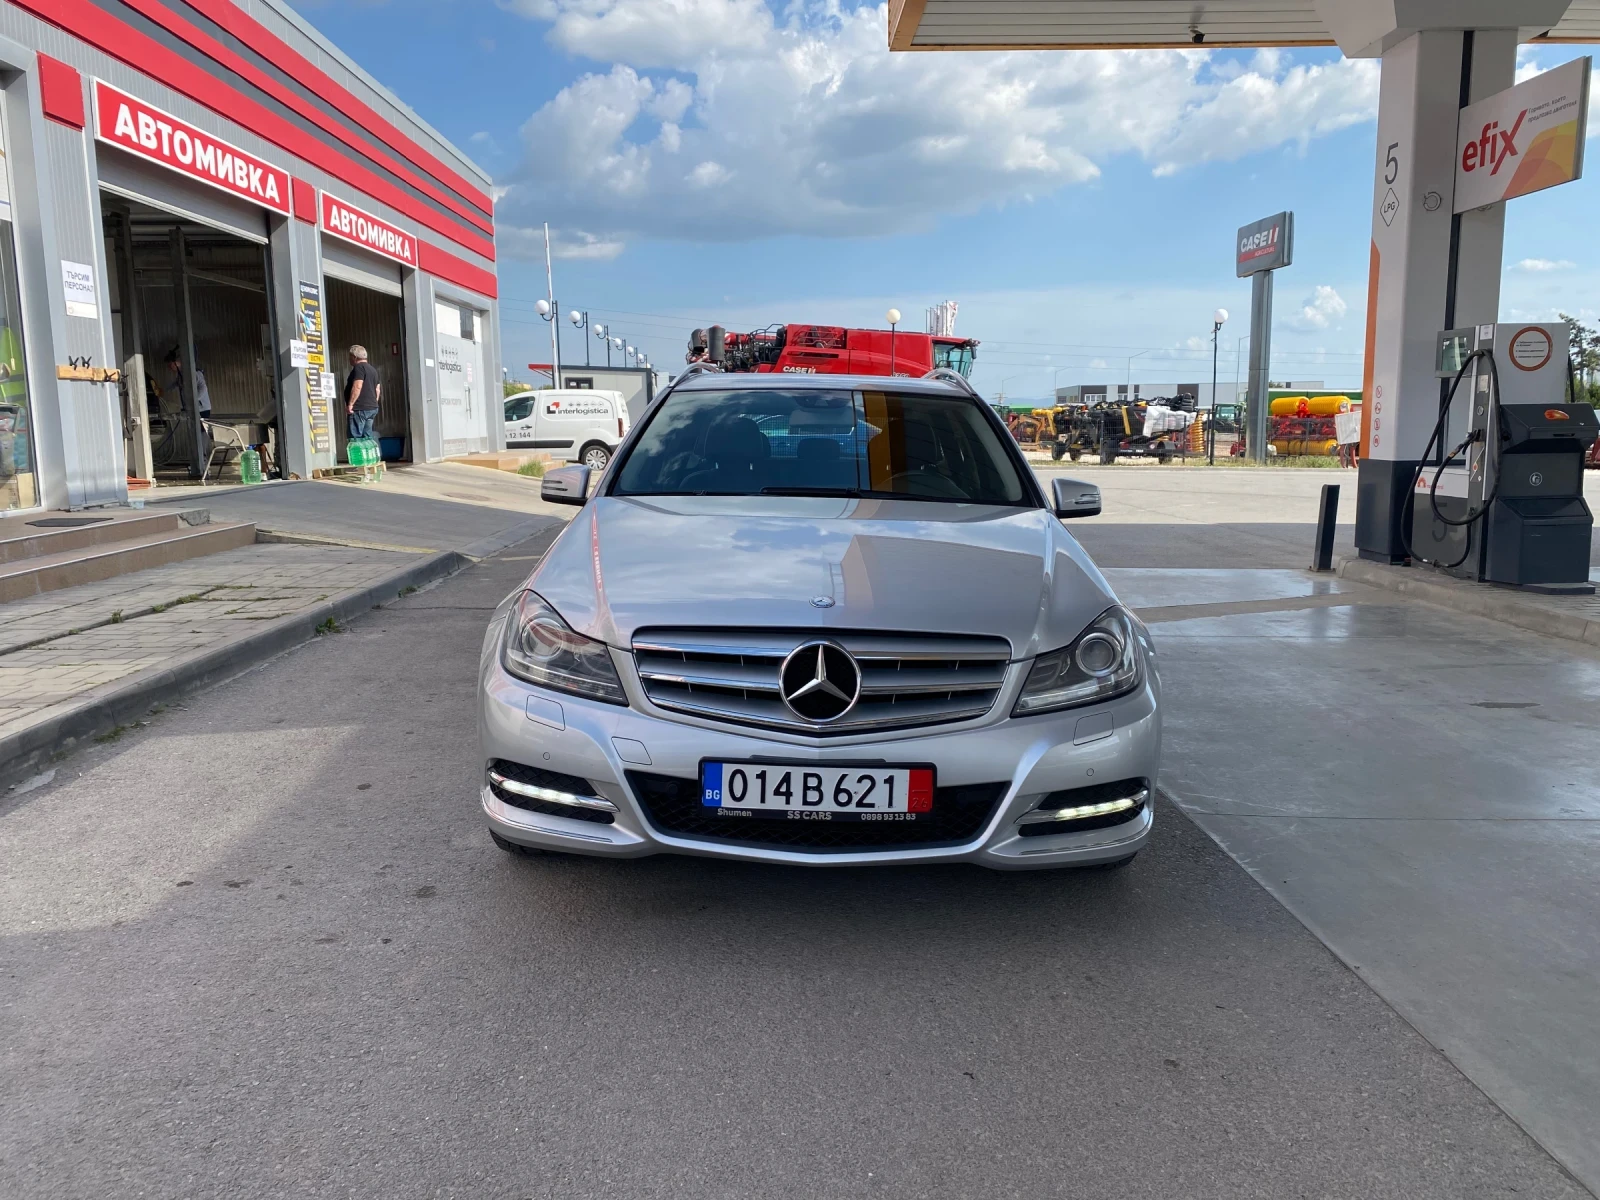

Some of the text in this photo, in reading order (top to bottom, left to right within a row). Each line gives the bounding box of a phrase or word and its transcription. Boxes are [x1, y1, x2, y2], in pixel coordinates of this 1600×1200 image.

[1462, 108, 1529, 176] efix
[114, 102, 281, 203] АВТОМИВКА
[1384, 141, 1399, 185] 5
[1383, 201, 1396, 213] LPG
[329, 204, 412, 261] АВТОМИВКА
[66, 270, 91, 282] ТЪРСИМ
[64, 280, 94, 293] ПЕРСОНАЛ
[557, 406, 609, 415] interlogistica
[705, 789, 720, 801] BG
[716, 807, 752, 818] Shumen
[787, 810, 832, 821] SS CARS
[860, 812, 883, 821] 0898
